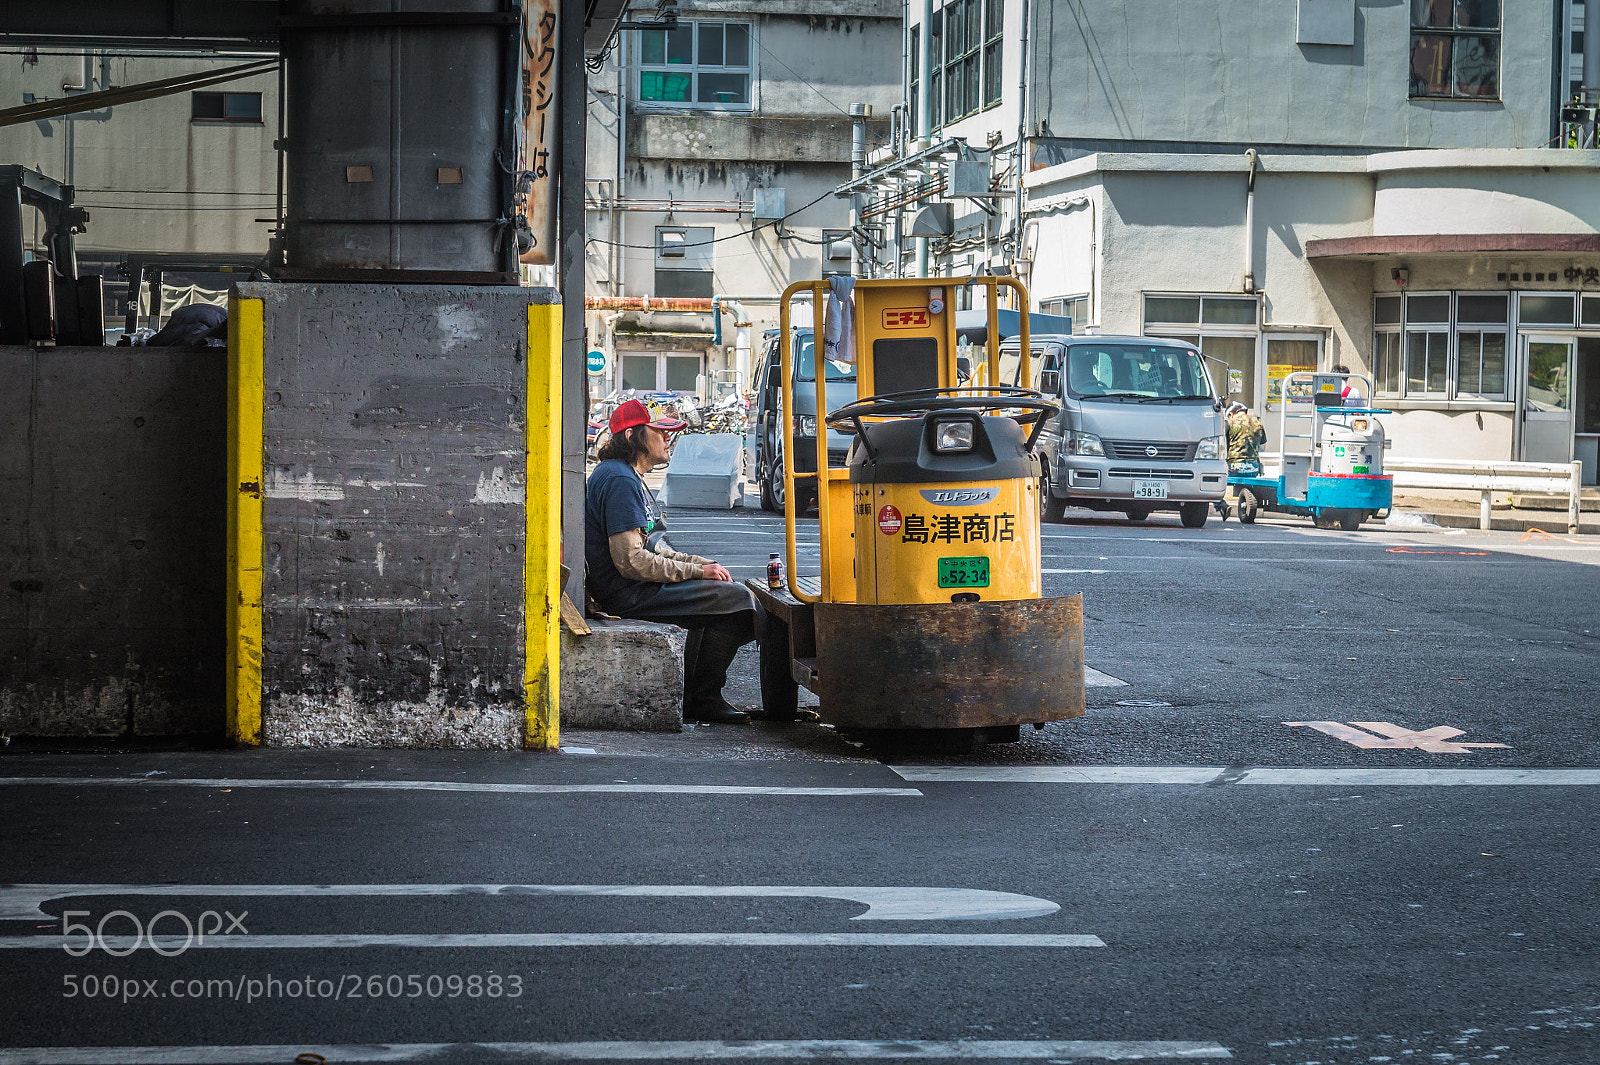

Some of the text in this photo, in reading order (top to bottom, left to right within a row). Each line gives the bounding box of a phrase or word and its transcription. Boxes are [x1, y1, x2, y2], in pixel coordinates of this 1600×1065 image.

[126, 300, 138, 311] 18
[1141, 487, 1165, 498] 98-91
[901, 512, 1015, 545] 島津商店
[950, 569, 988, 584] 52-34
